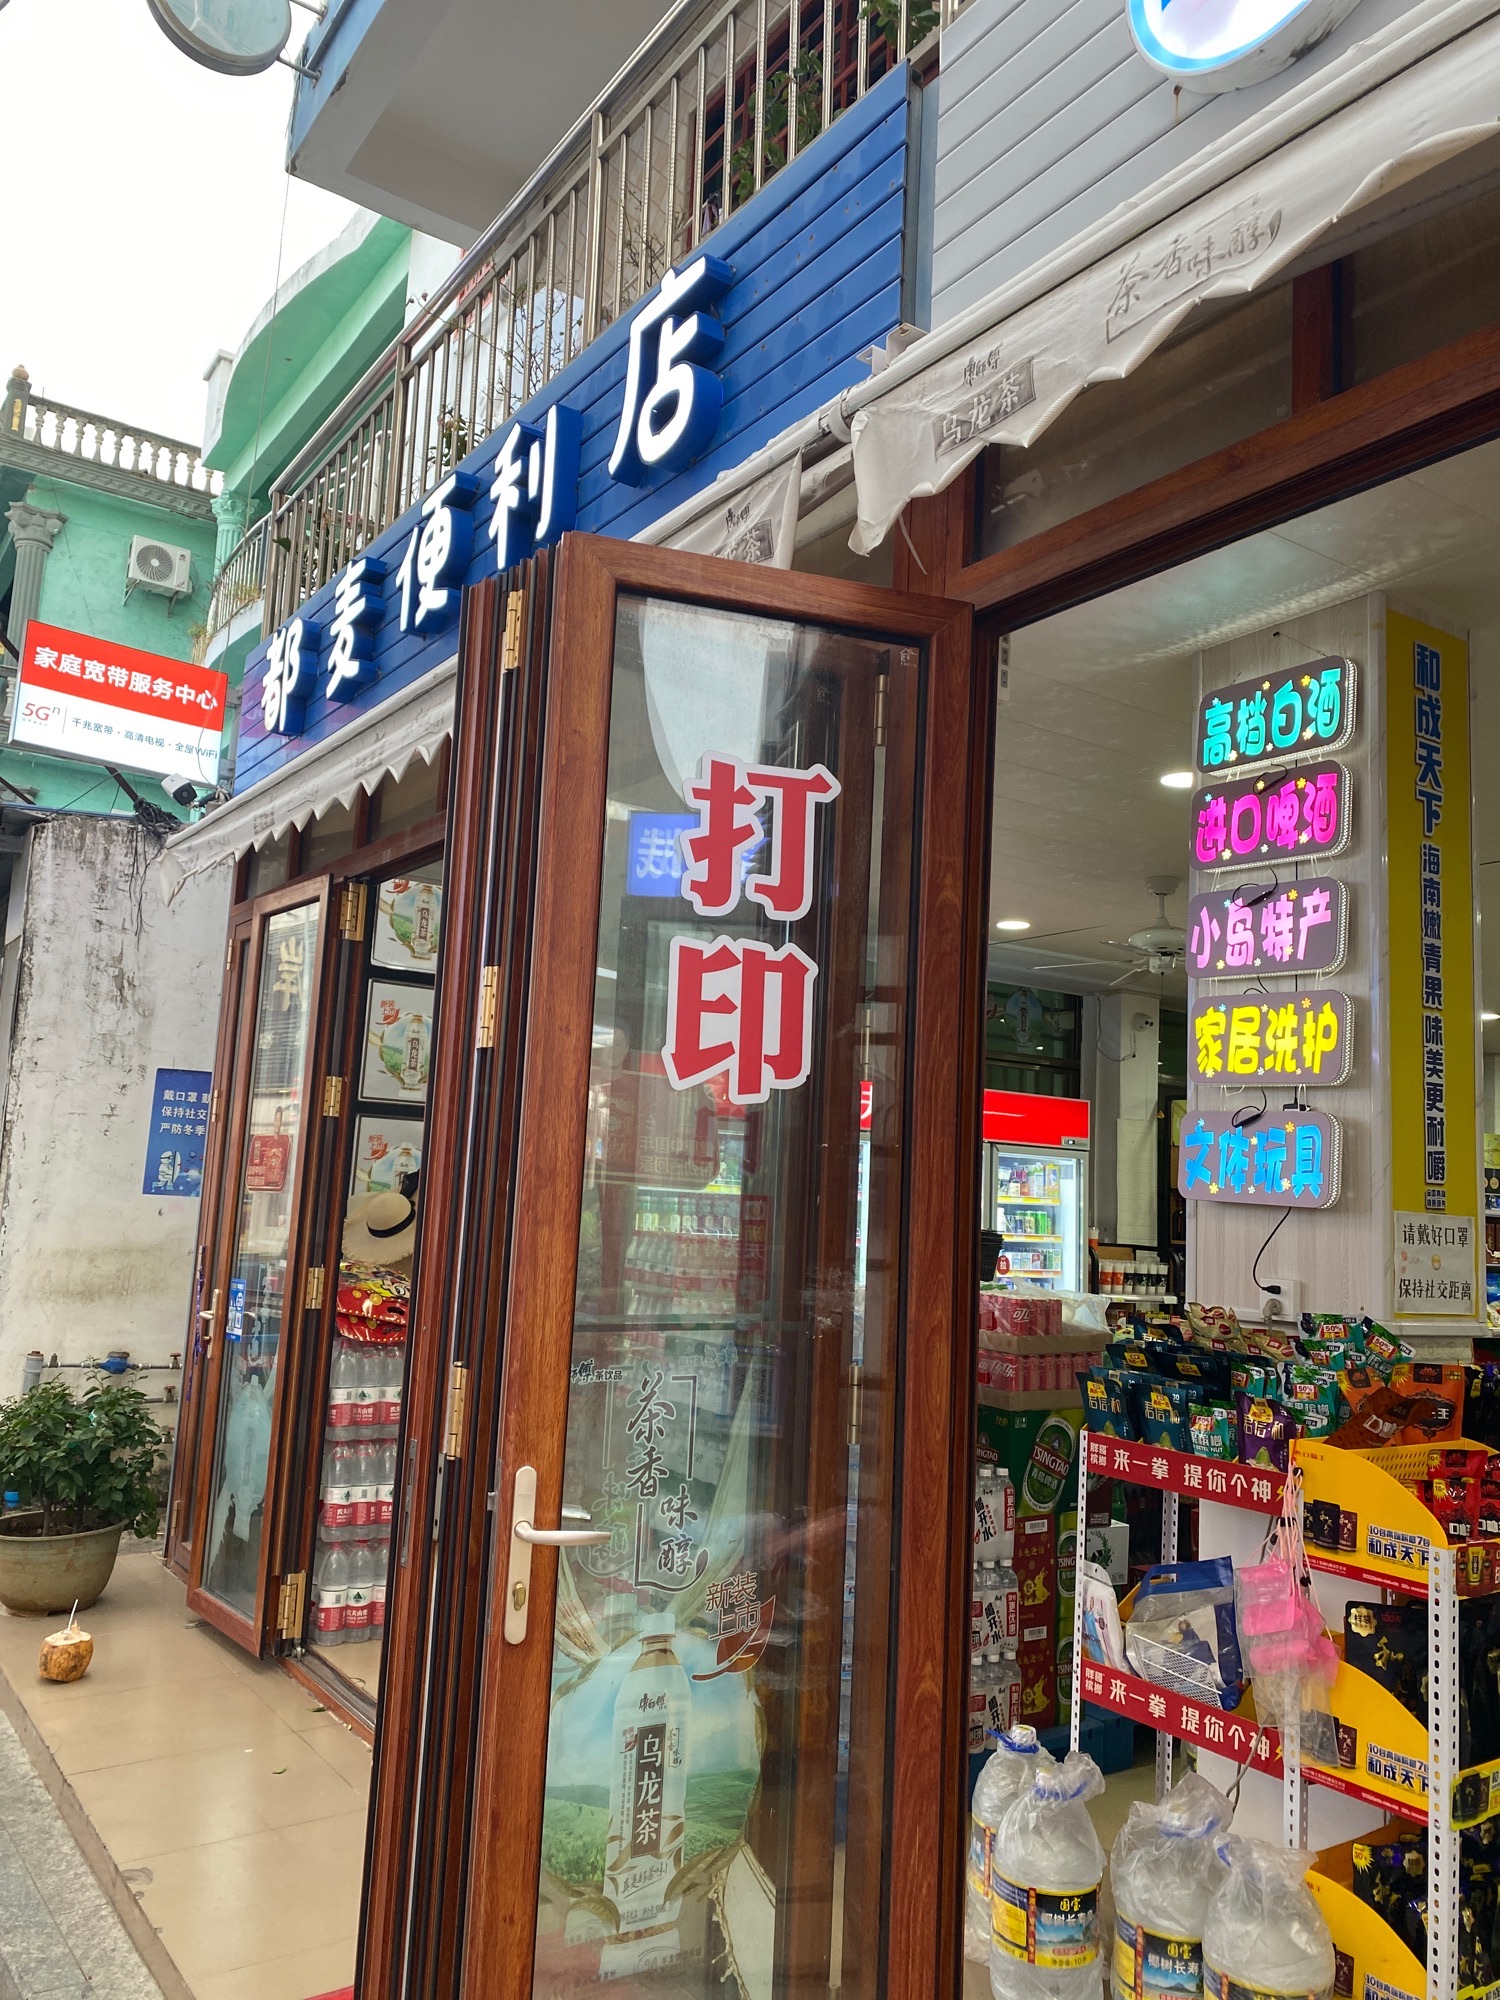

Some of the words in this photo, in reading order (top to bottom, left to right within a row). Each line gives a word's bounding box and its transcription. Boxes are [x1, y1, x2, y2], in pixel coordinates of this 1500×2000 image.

[1107, 211, 1268, 317] 茶香味醇
[941, 371, 1021, 449] 乌龙茶
[261, 254, 706, 732] 都麦便利店
[34, 645, 219, 711] 家庭宽带服务中心
[1203, 667, 1341, 767] 高档白酒
[1413, 640, 1445, 837] 和成天下
[1195, 772, 1338, 863] 进口啤酒
[664, 754, 839, 1100] 打印
[1190, 886, 1332, 969] 小岛特产
[1420, 844, 1446, 1010] 海南嫩青果
[1194, 1001, 1339, 1075] 家居洗护
[158, 1122, 206, 1137] 严防冬季
[161, 1105, 208, 1121] 保持社交
[162, 1089, 198, 1104] 戴口罩
[1422, 1012, 1447, 1186] 味美更耐嚼
[1184, 1123, 1324, 1199] 文体玩具
[1402, 1223, 1469, 1248] 请戴好口罩
[1398, 1277, 1472, 1302] 保持社交距离
[1374, 1338, 1391, 1351] 50%
[626, 1371, 699, 1576] 茶香味醇
[1032, 1445, 1070, 1477] TSINGTAO
[1112, 1448, 1170, 1481] 来一拳
[1183, 1462, 1273, 1504] 提你个神
[1368, 1536, 1430, 1566] 和成天下
[705, 1572, 758, 1612] 新装
[708, 1602, 761, 1640] 上市
[1110, 1677, 1167, 1719] 来一拳
[1180, 1705, 1270, 1763] 提你个神
[635, 1734, 663, 1846] 乌龙茶
[1367, 1755, 1429, 1792] 和成天下
[1060, 1898, 1082, 1912] 国宝
[1167, 1942, 1192, 1960] 国宝
